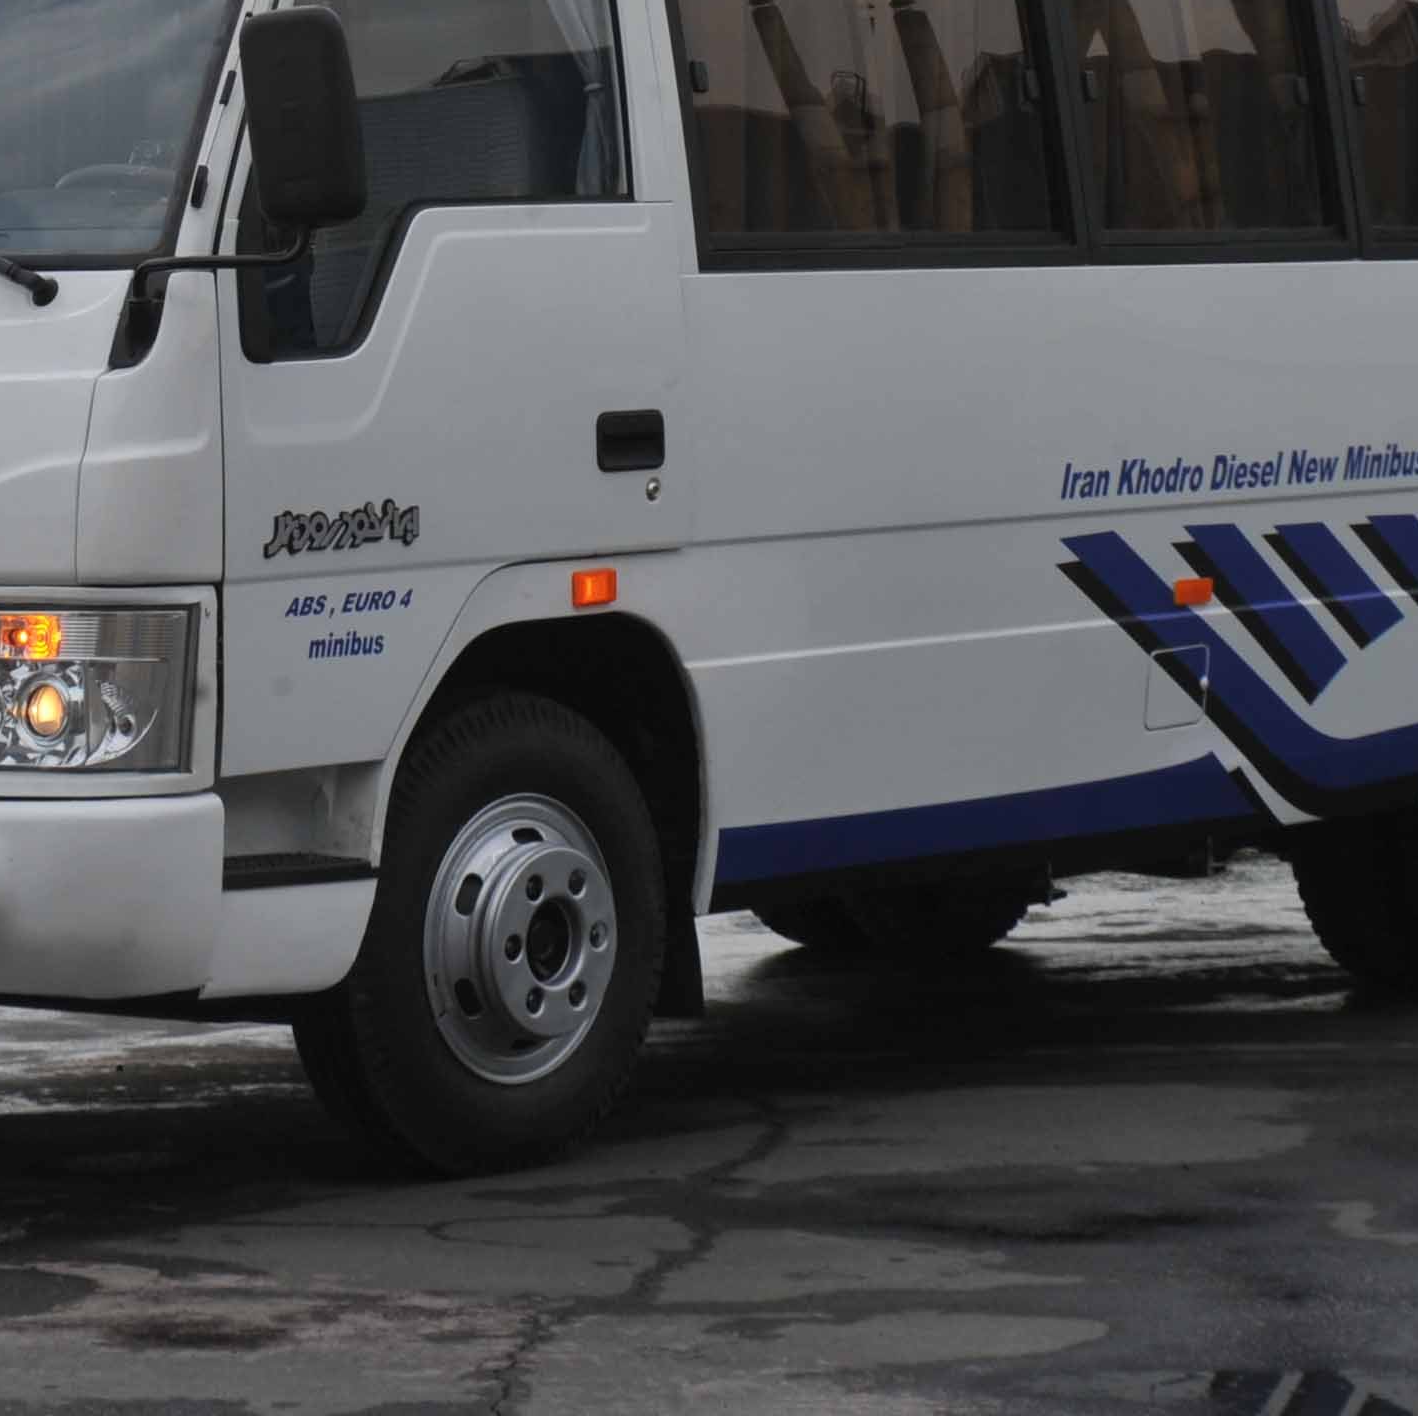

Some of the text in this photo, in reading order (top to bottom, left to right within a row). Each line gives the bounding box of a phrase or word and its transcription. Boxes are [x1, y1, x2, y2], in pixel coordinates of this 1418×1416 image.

[1060, 463, 1109, 500] Iran
[1117, 457, 1204, 496] Khodro
[1210, 451, 1283, 491] Diesel
[1288, 448, 1338, 485] New
[341, 590, 396, 613] EURO
[400, 589, 413, 608] 4
[308, 631, 385, 659] minibus
